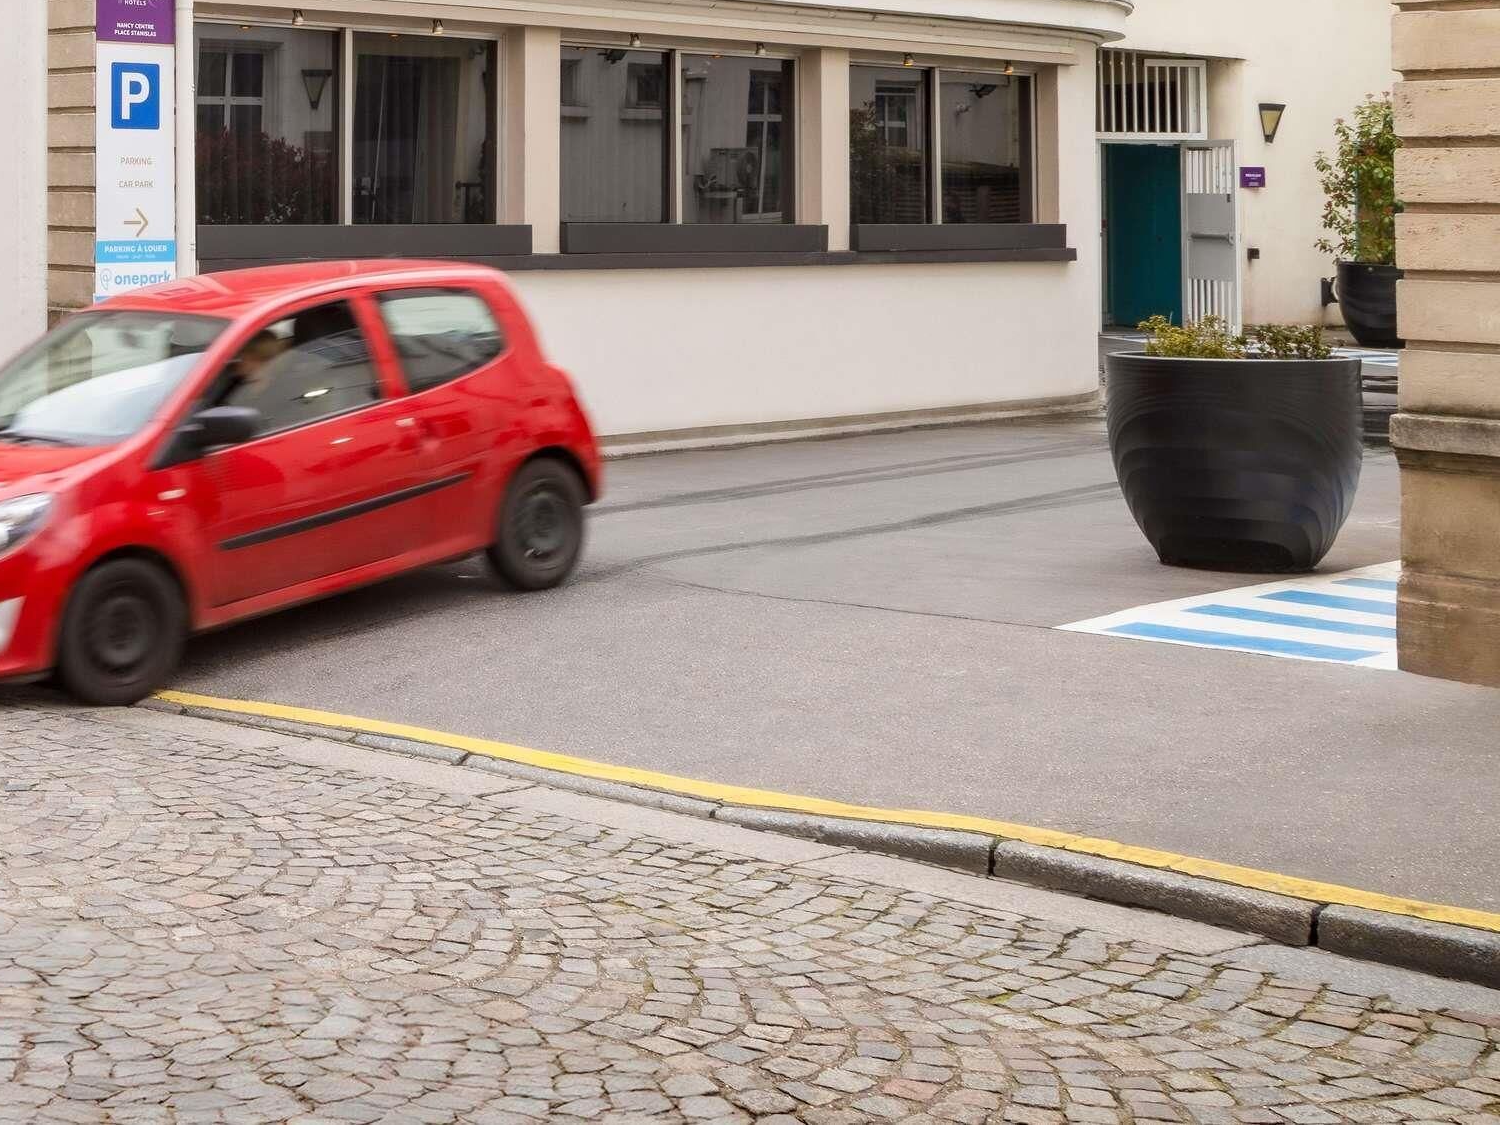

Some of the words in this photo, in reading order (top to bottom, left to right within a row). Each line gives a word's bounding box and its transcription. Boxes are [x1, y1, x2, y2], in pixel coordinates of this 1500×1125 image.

[121, 71, 150, 120] P
[120, 157, 152, 166] PARKING
[118, 180, 133, 188] CAR
[134, 180, 154, 188] PARK
[114, 270, 171, 286] onepark
